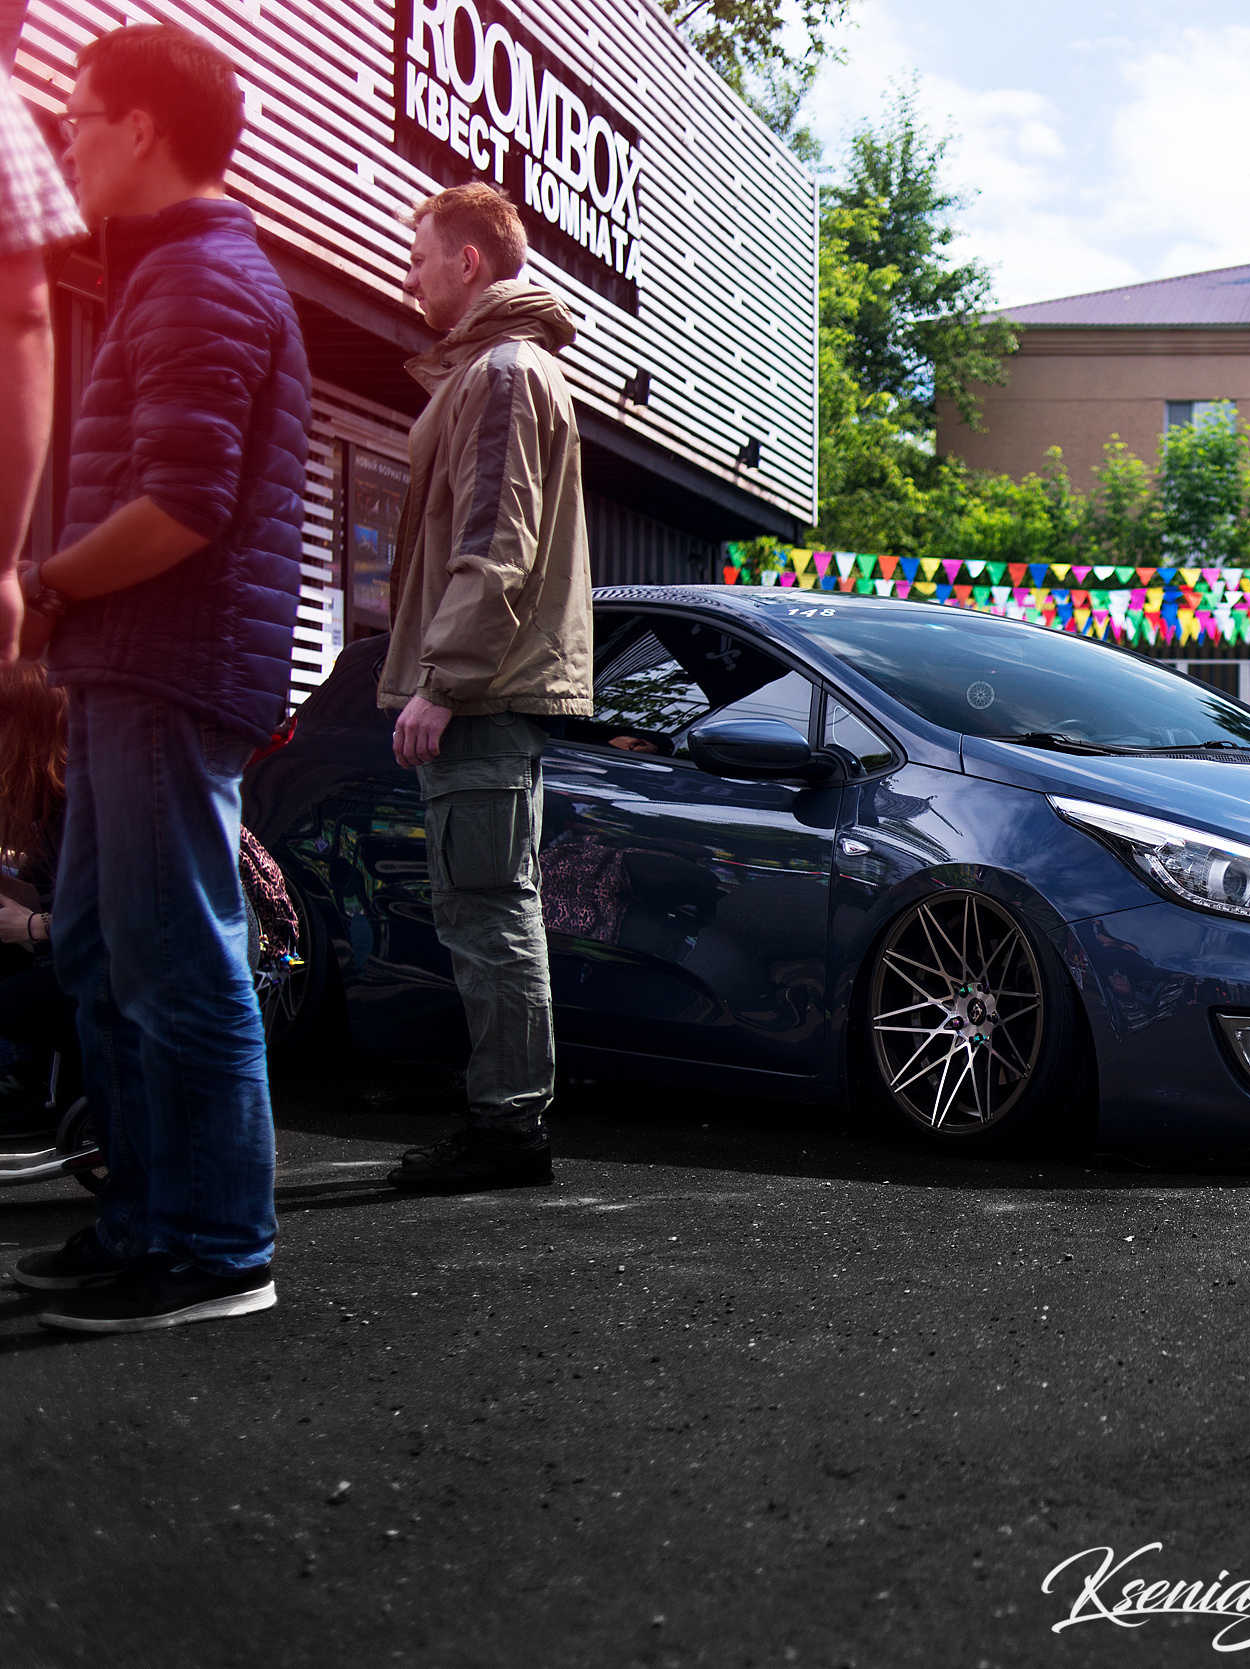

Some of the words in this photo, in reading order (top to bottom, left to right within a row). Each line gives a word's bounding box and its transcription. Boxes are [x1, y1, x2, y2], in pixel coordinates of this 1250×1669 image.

[406, 0, 642, 240] ROOMBOX
[406, 60, 510, 184] КВЕСТ
[524, 154, 642, 288] КОМНАТА
[788, 608, 836, 618] 148
